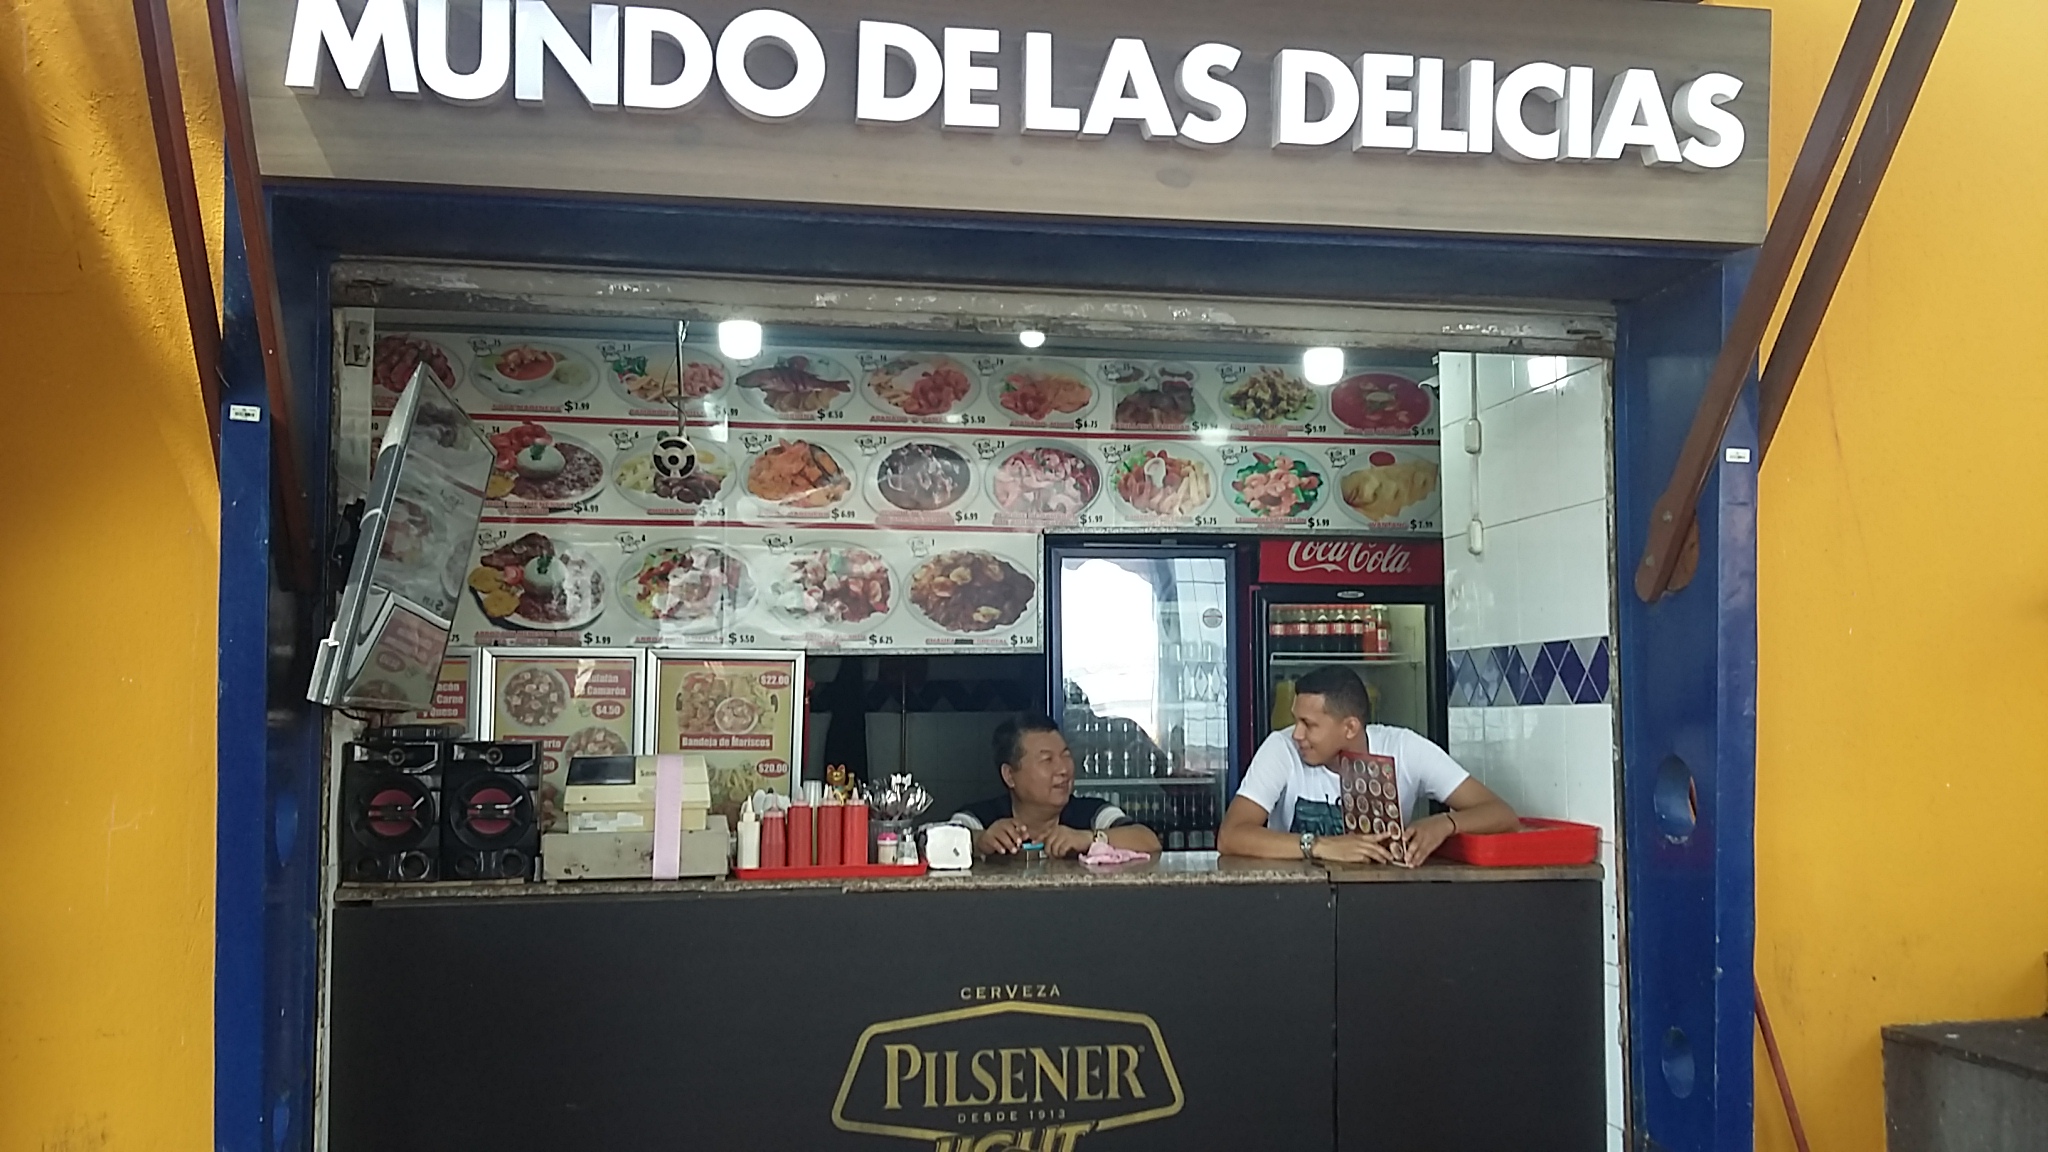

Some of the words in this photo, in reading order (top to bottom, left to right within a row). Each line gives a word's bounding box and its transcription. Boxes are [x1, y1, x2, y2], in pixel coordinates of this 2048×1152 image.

[284, 0, 826, 118] MUNDO
[856, 20, 1000, 129] DE
[1022, 32, 1247, 145] LAS
[1276, 48, 1746, 169] DELICIAS
[760, 674, 790, 686] $22.00
[595, 705, 621, 715] $4.50
[682, 736, 717, 748] Bandeja
[719, 736, 730, 747] de
[731, 735, 771, 747] Mariscos
[758, 763, 788, 774] $20.00
[960, 984, 1060, 1000] CERVEZA
[884, 1043, 1147, 1111] PILSENER
[957, 1110, 1018, 1124] DESDE
[1029, 1108, 1066, 1121] 1913
